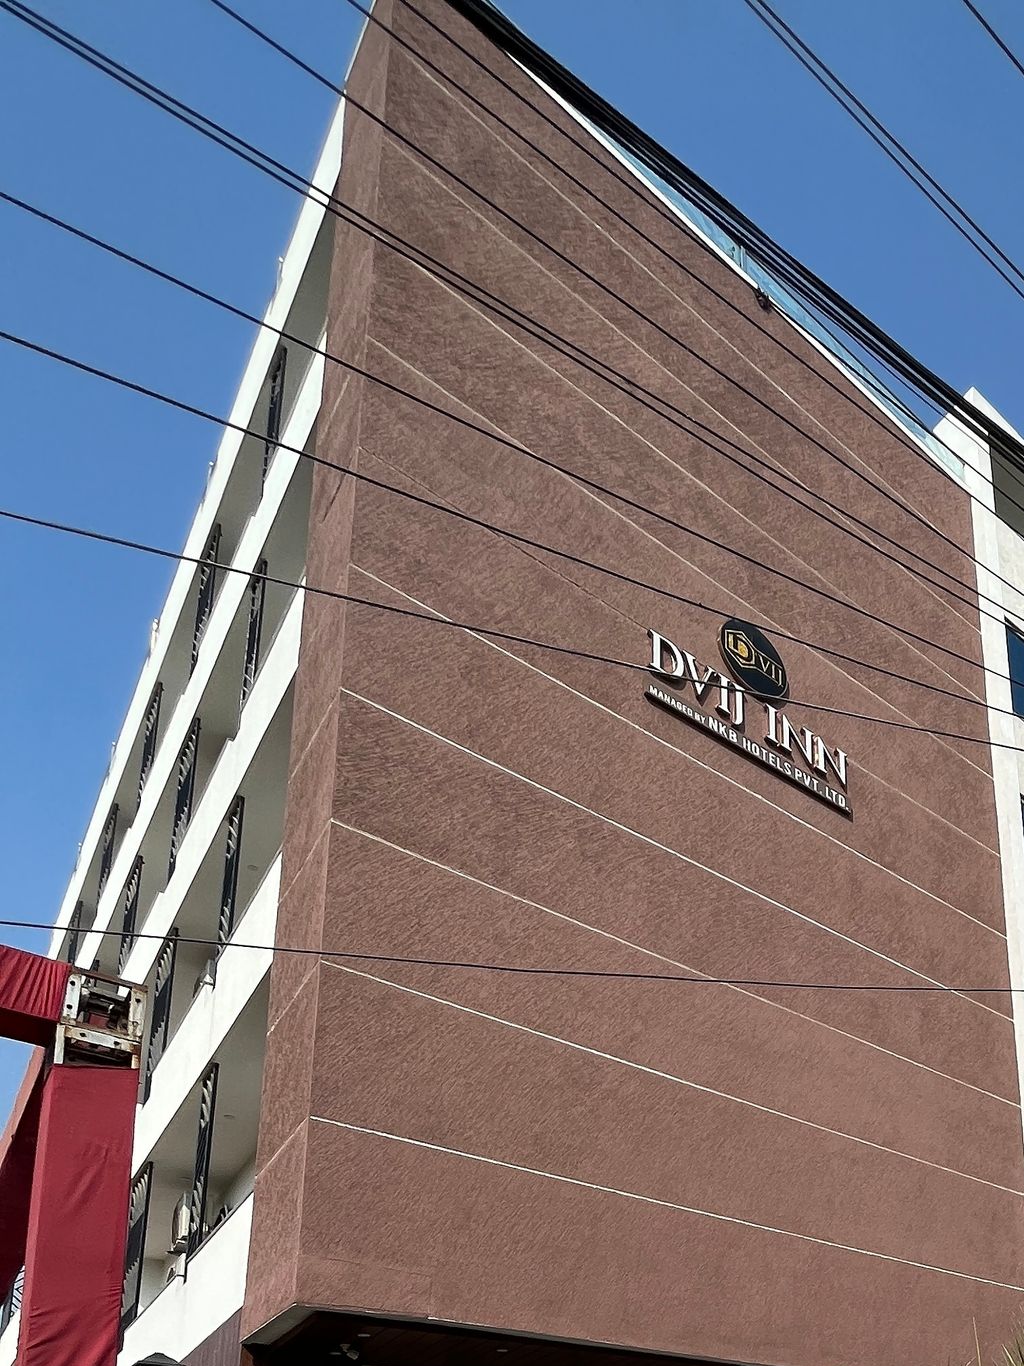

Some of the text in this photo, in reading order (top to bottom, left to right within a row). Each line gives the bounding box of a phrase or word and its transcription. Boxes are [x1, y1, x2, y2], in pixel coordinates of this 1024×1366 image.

[649, 629, 848, 785] DVIJ INN
[649, 685, 849, 811] MANAGED BY NKB HOTELS PVT. LTD.
